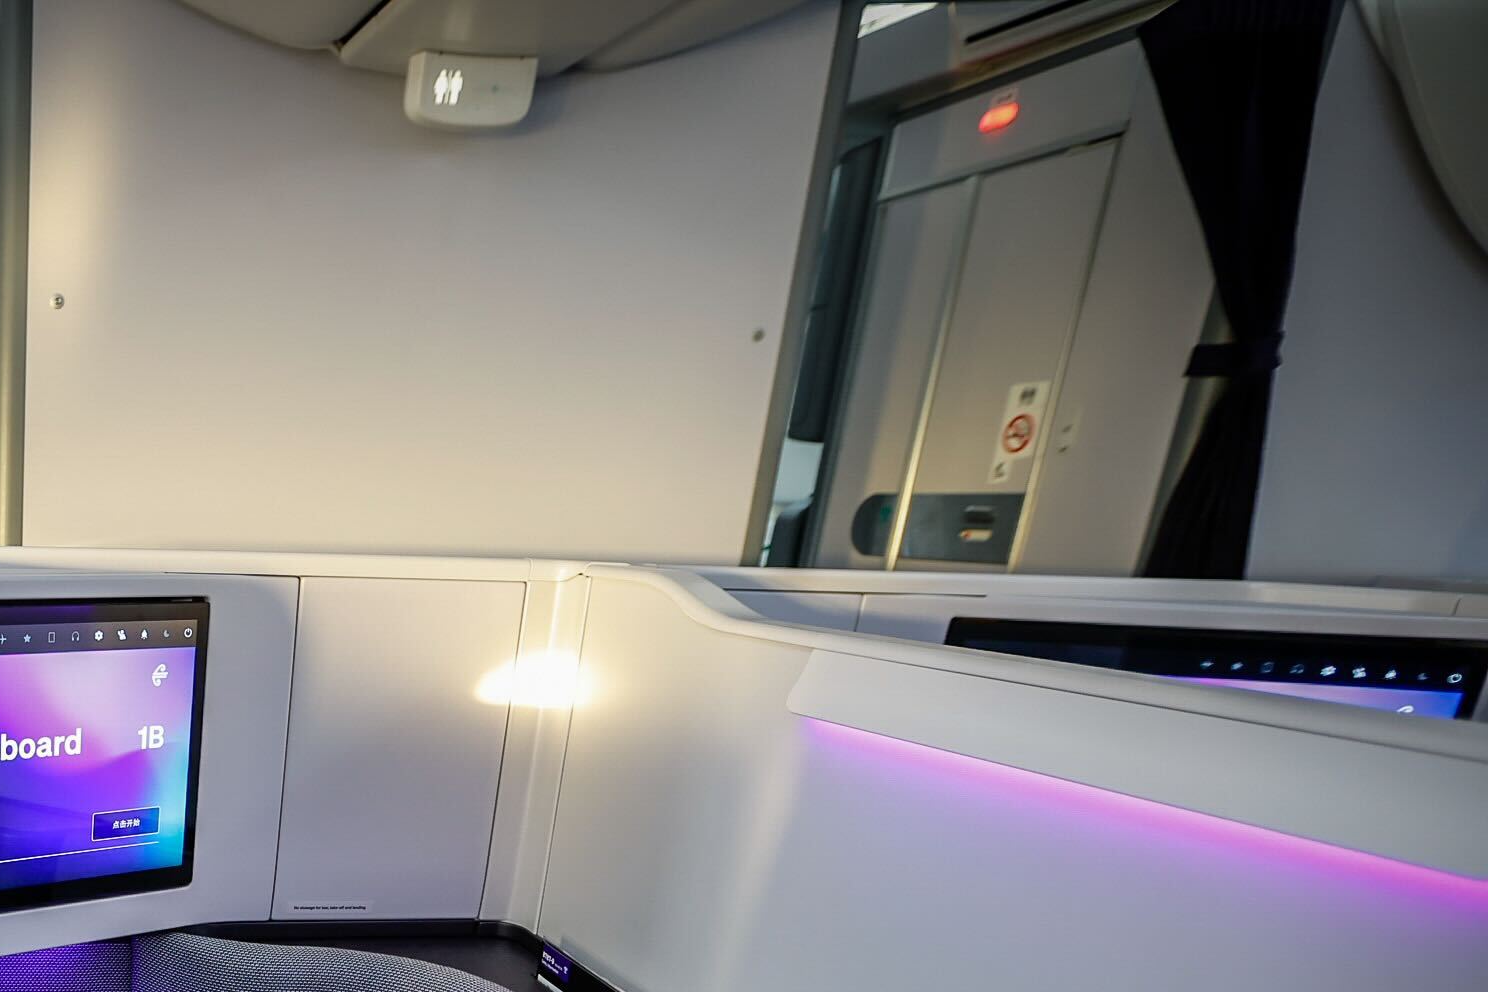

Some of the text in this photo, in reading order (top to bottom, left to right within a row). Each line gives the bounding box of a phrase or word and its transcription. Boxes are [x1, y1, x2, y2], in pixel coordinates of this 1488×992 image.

[137, 725, 166, 750] 1B
[112, 818, 141, 830] 点击开始
